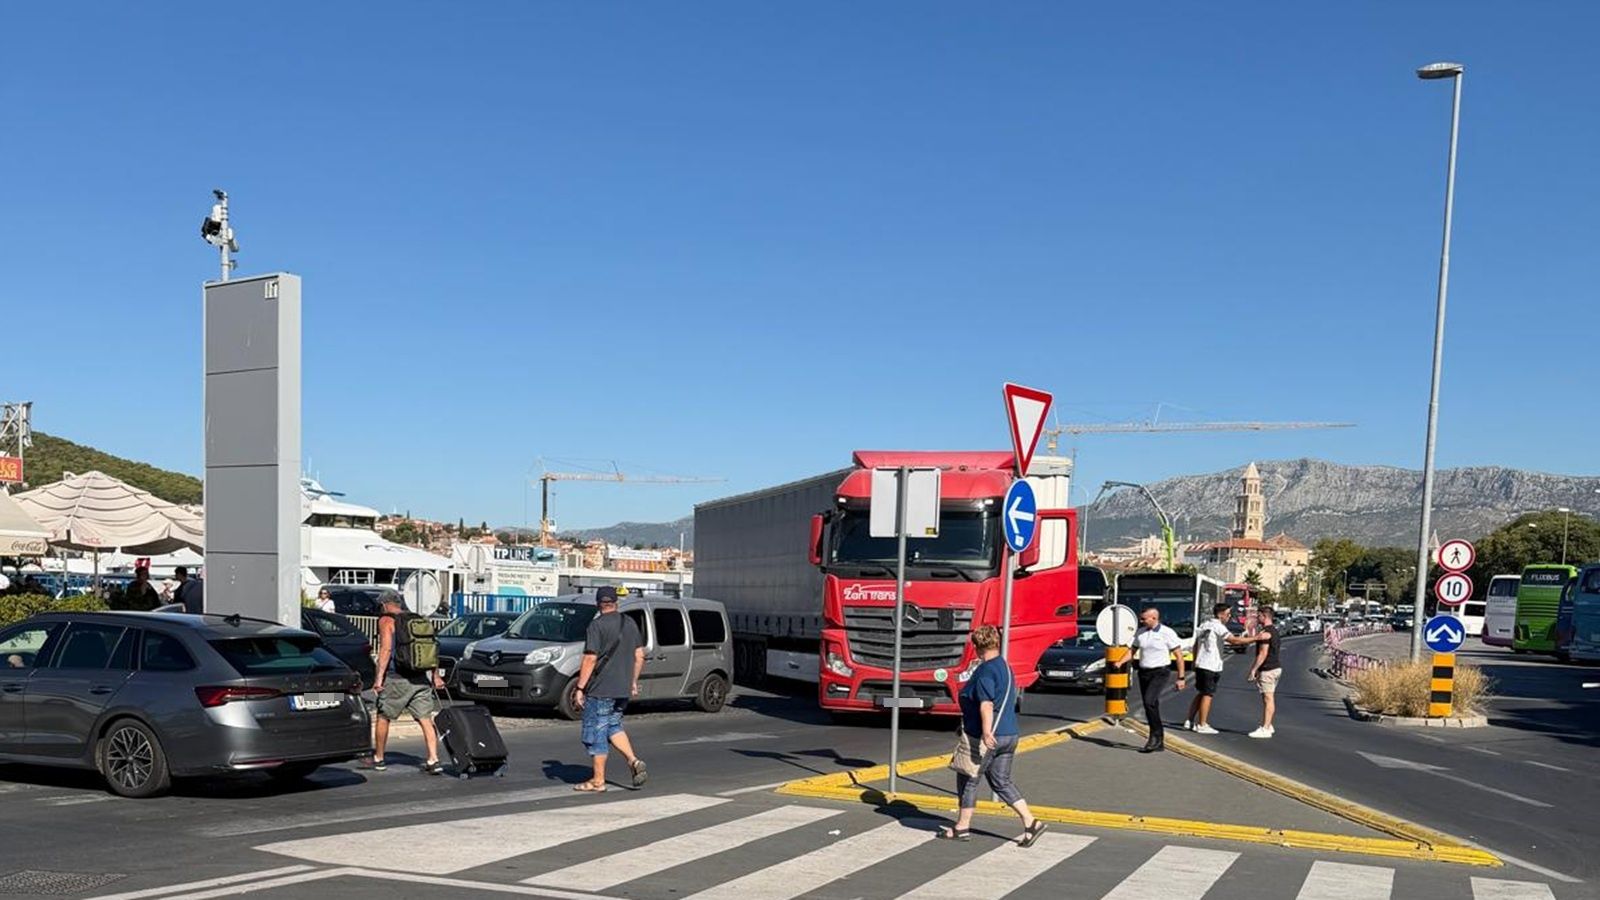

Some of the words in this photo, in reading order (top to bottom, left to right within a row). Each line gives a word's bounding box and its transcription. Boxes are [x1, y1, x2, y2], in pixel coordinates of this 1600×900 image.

[510, 548, 530, 561] LINE
[1531, 573, 1560, 581] FLIXBUS
[1446, 581, 1462, 597] 10
